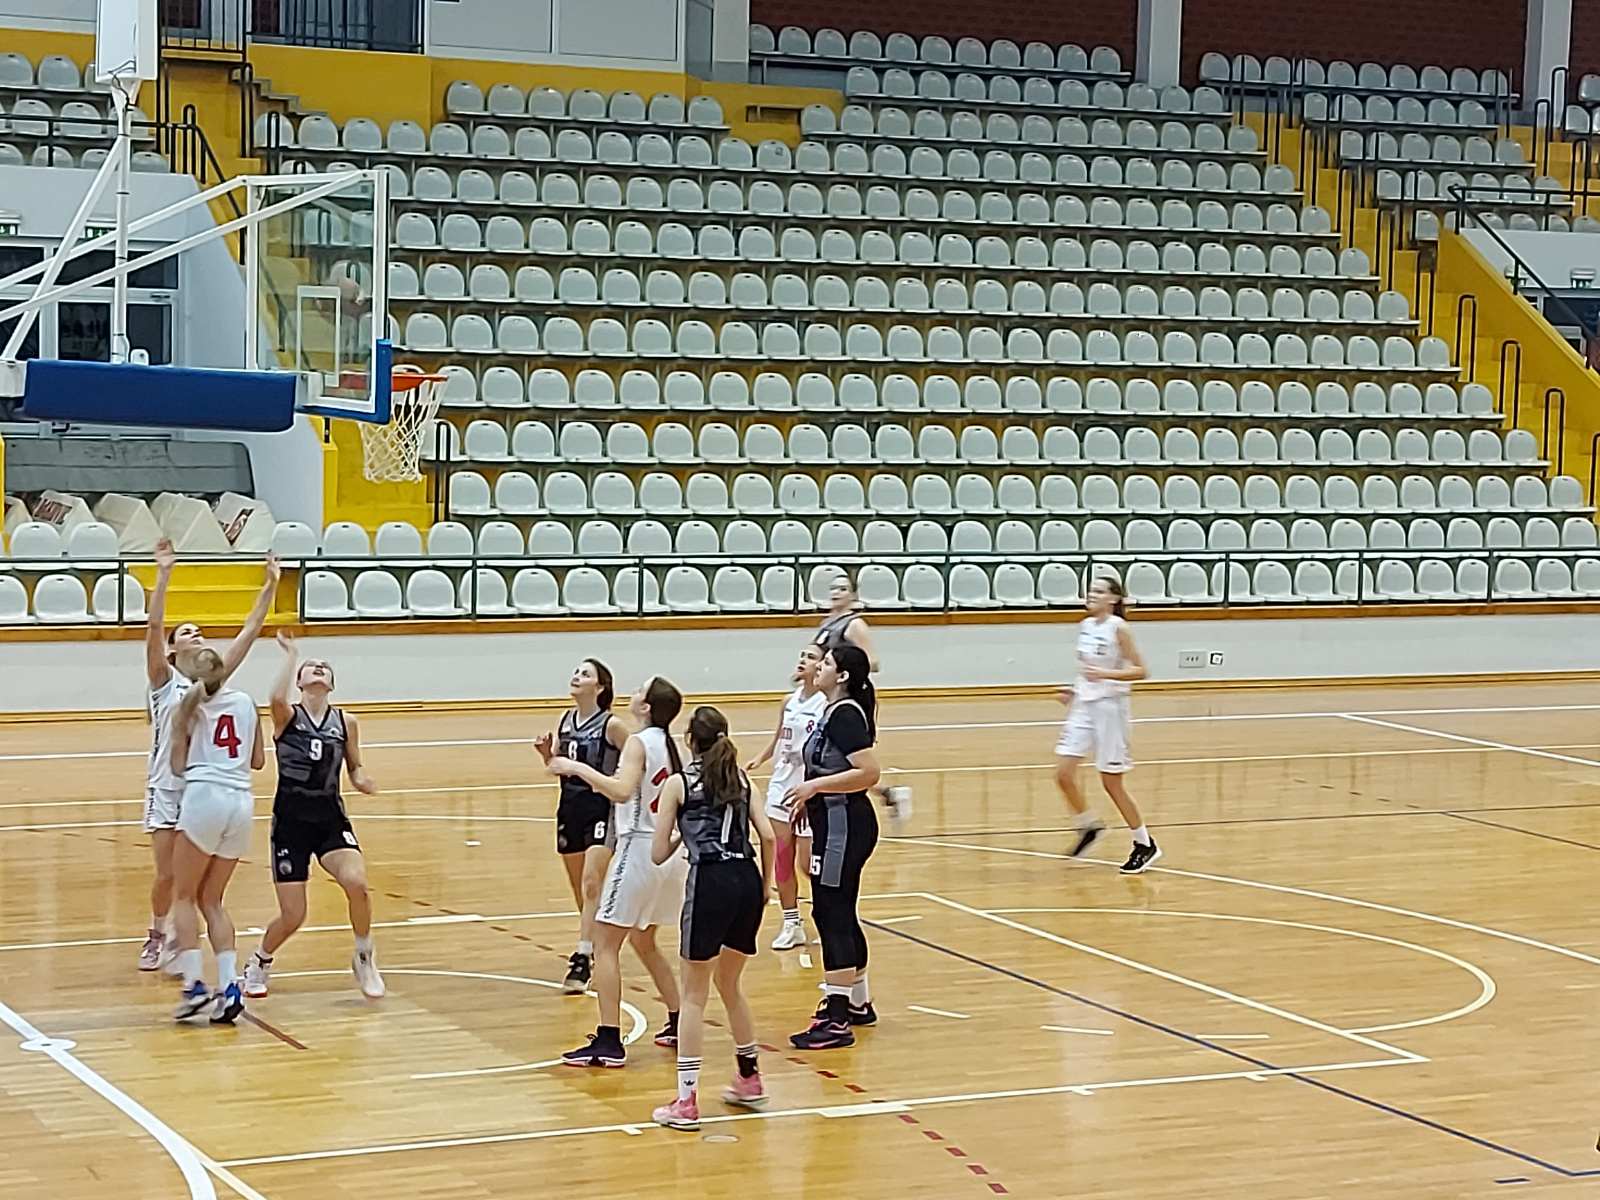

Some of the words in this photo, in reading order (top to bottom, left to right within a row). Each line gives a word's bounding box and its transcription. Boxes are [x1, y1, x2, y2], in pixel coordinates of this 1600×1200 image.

[213, 713, 242, 759] 4
[309, 738, 322, 761] 9
[594, 820, 606, 839] 6
